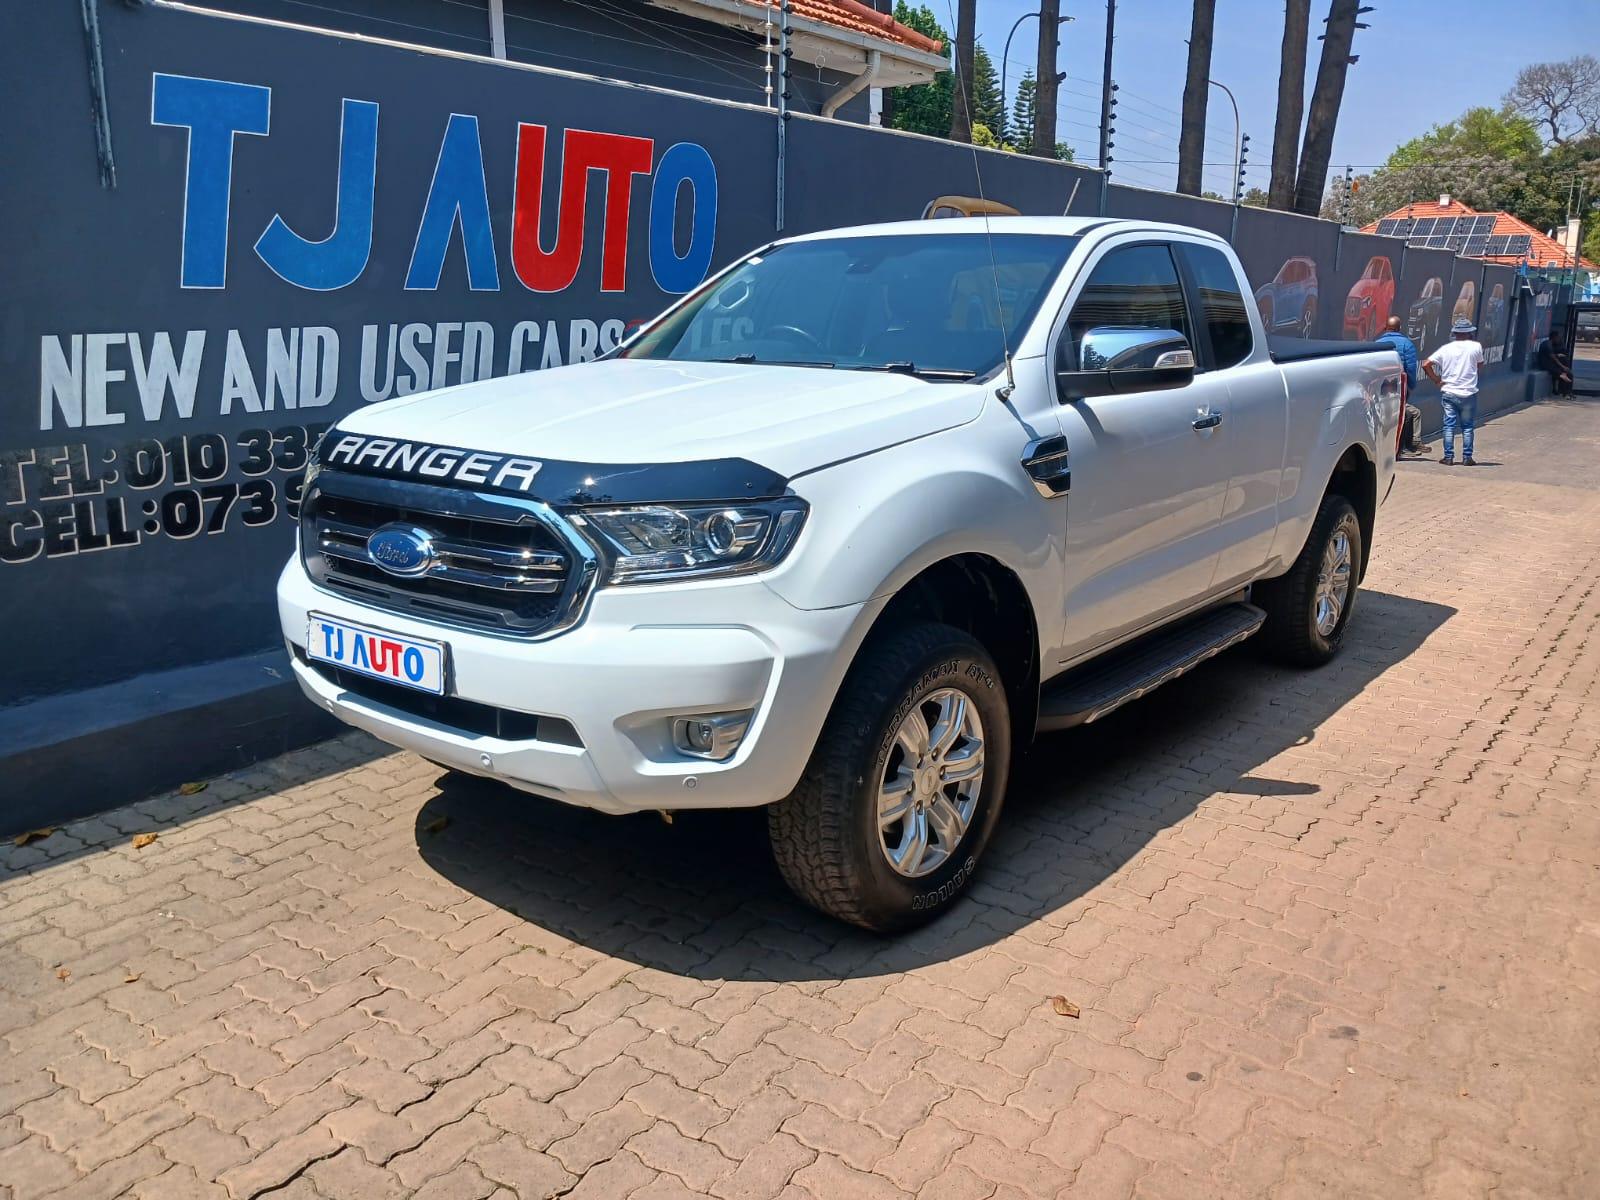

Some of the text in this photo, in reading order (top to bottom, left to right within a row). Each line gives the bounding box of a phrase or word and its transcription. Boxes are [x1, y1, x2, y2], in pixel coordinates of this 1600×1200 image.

[151, 72, 719, 294] TJ AUTO
[40, 330, 206, 430] NEW
[219, 326, 340, 415] AND
[359, 321, 495, 402] USED
[508, 319, 626, 376] CARS
[328, 436, 543, 491] RANGER
[321, 623, 425, 682] TJ AUTO
